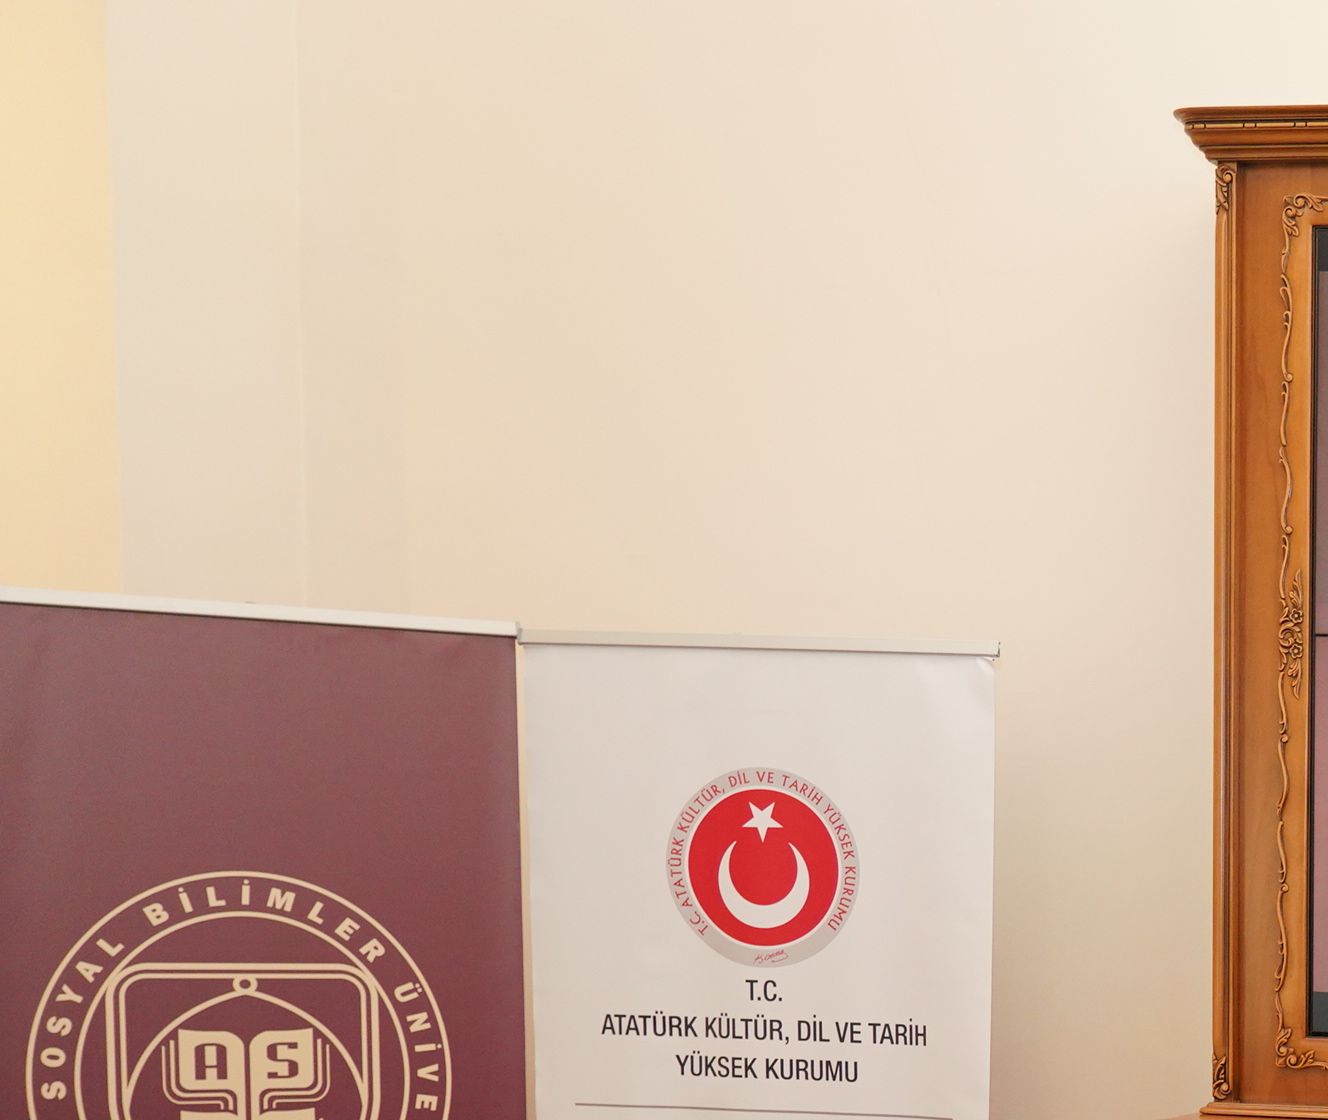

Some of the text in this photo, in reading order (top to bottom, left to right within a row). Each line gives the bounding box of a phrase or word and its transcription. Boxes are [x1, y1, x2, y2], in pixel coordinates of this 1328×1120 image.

[669, 770, 857, 937] T.C. ATATÜRK KÜLTÜR, DİL VE TARİH YÜKSEK KURUMU
[41, 934, 125, 1101] SOSYAL
[142, 879, 386, 964] BİLİMLER
[745, 979, 783, 1002] T.C.
[601, 1011, 927, 1046] ATATÜRK KÜLTÜR, DİL VE TARİH
[675, 1052, 859, 1082] YÜKSEK KURUMU
